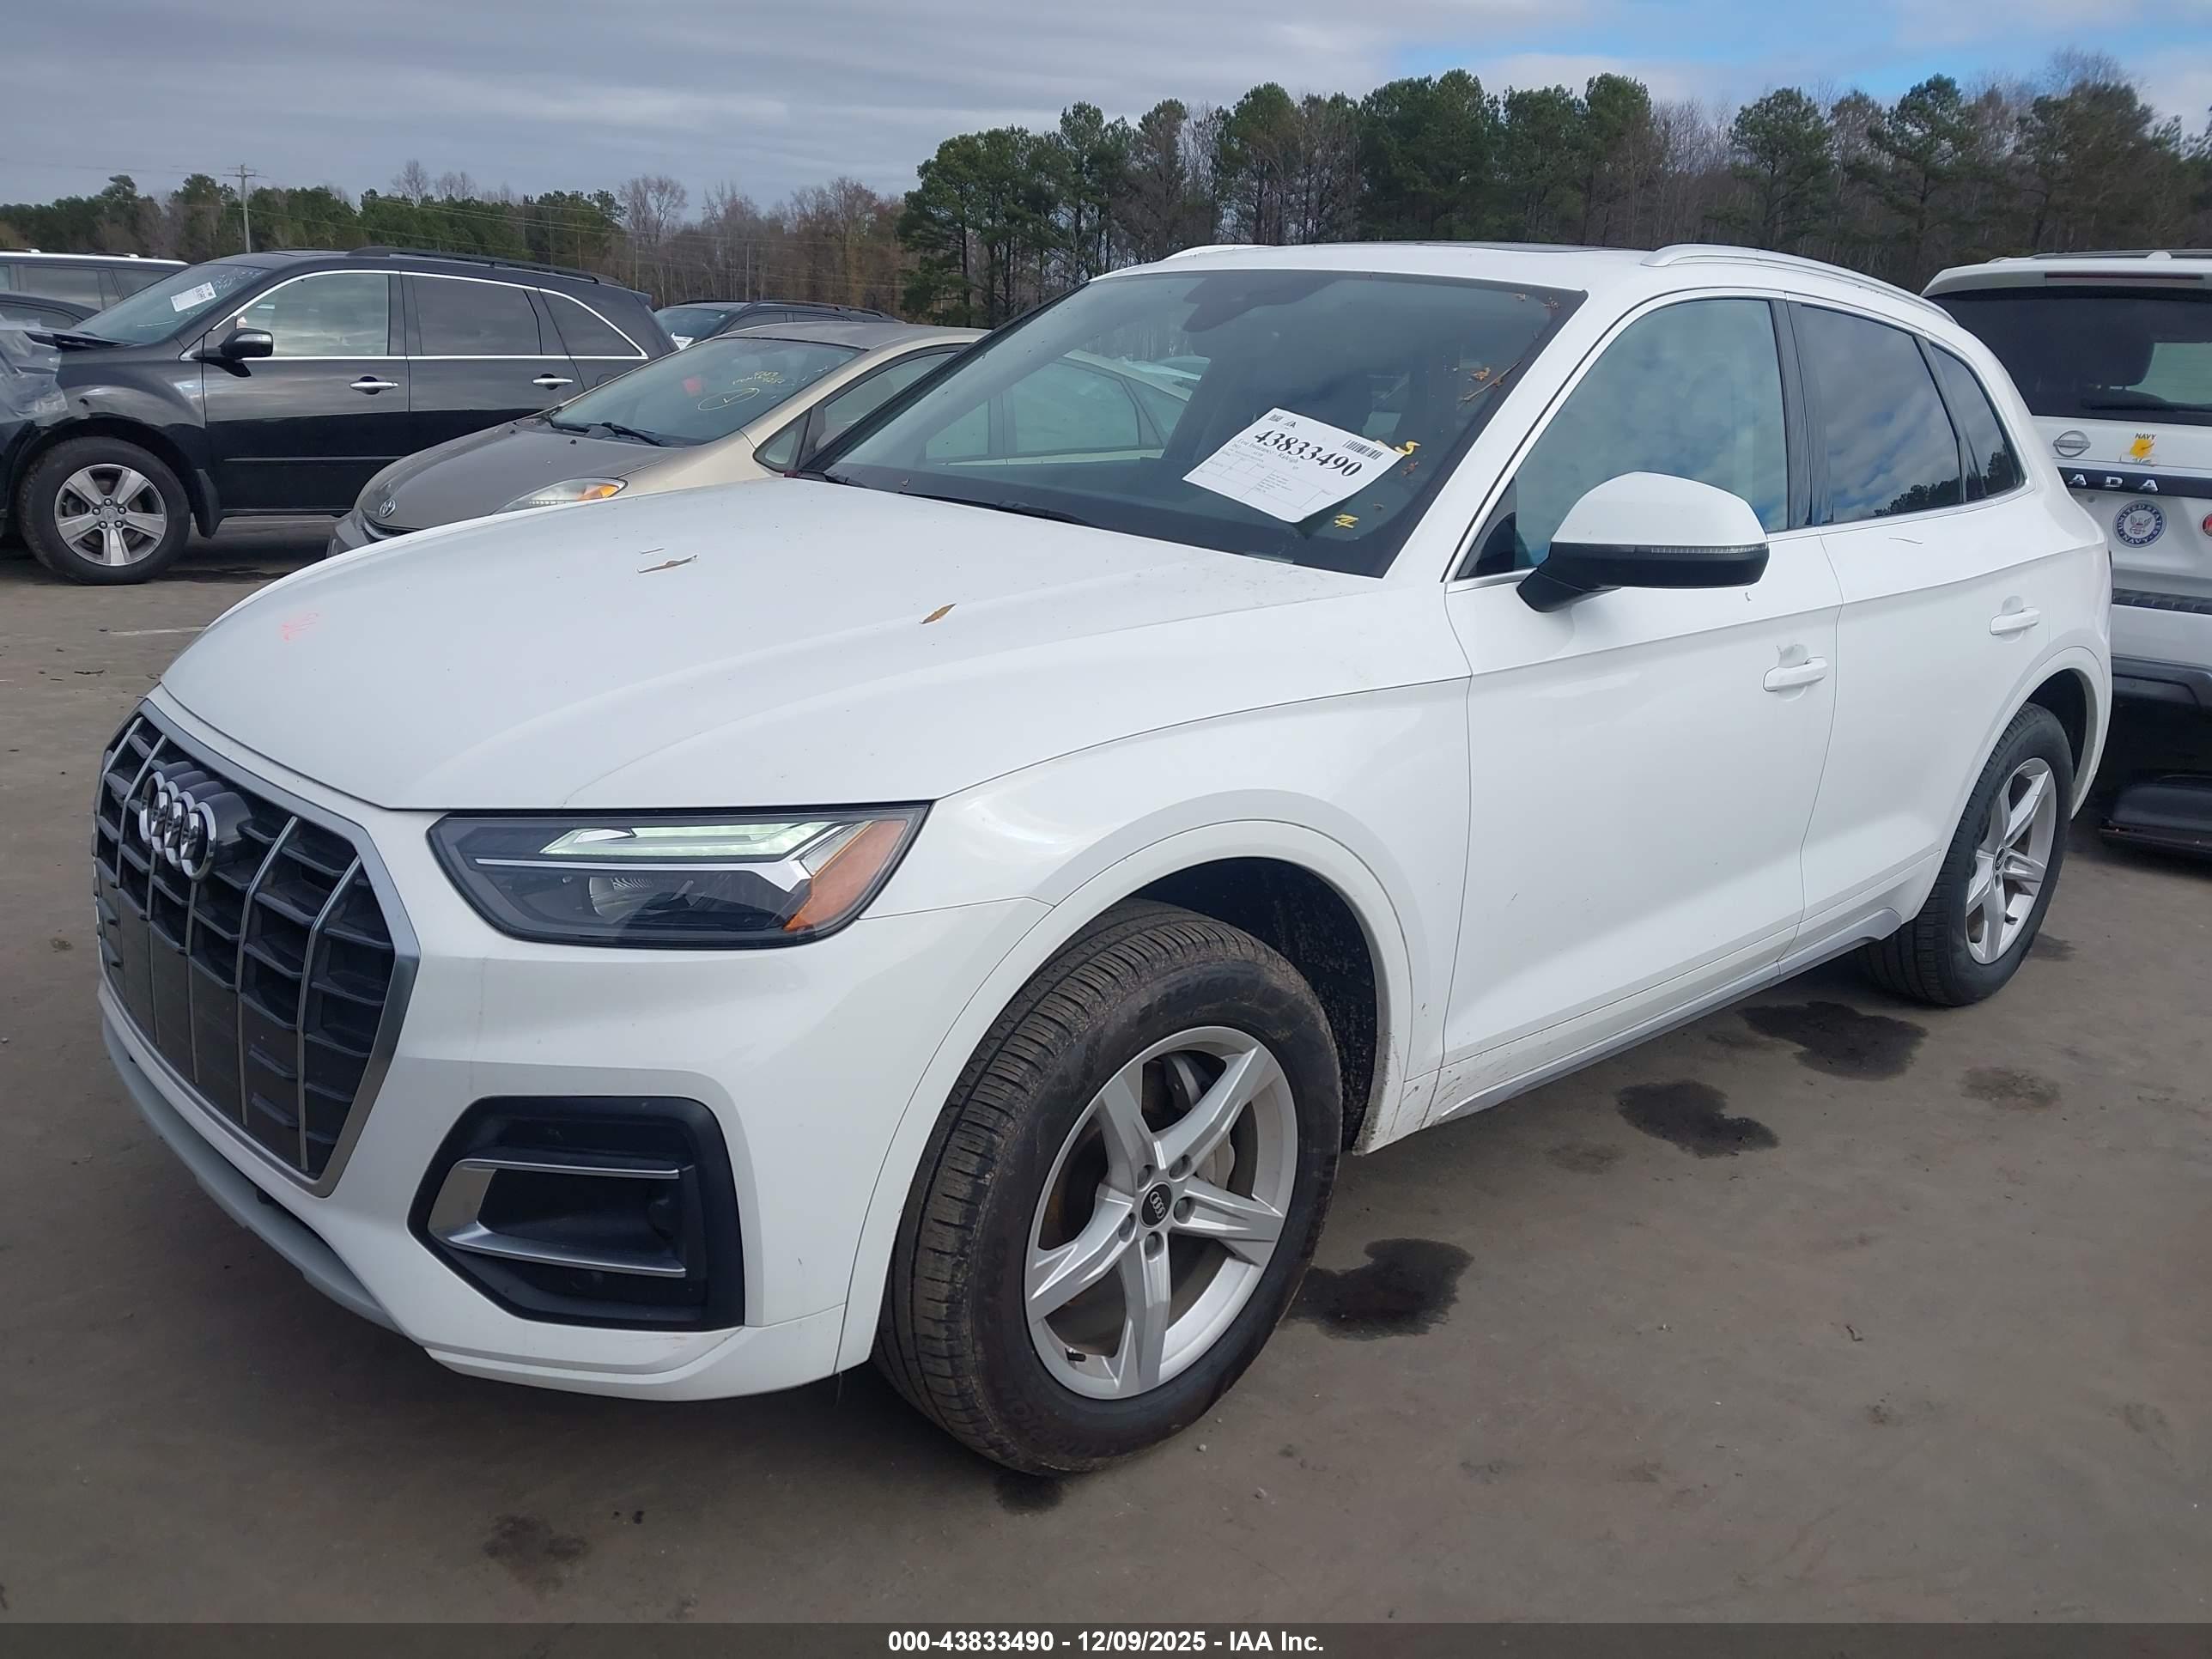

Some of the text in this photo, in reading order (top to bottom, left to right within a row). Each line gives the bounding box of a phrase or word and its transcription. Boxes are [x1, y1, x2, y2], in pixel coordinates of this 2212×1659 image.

[2135, 432, 2157, 441] NAVY
[1253, 428, 1364, 478] 43833490
[2122, 534, 2149, 544] NAVY
